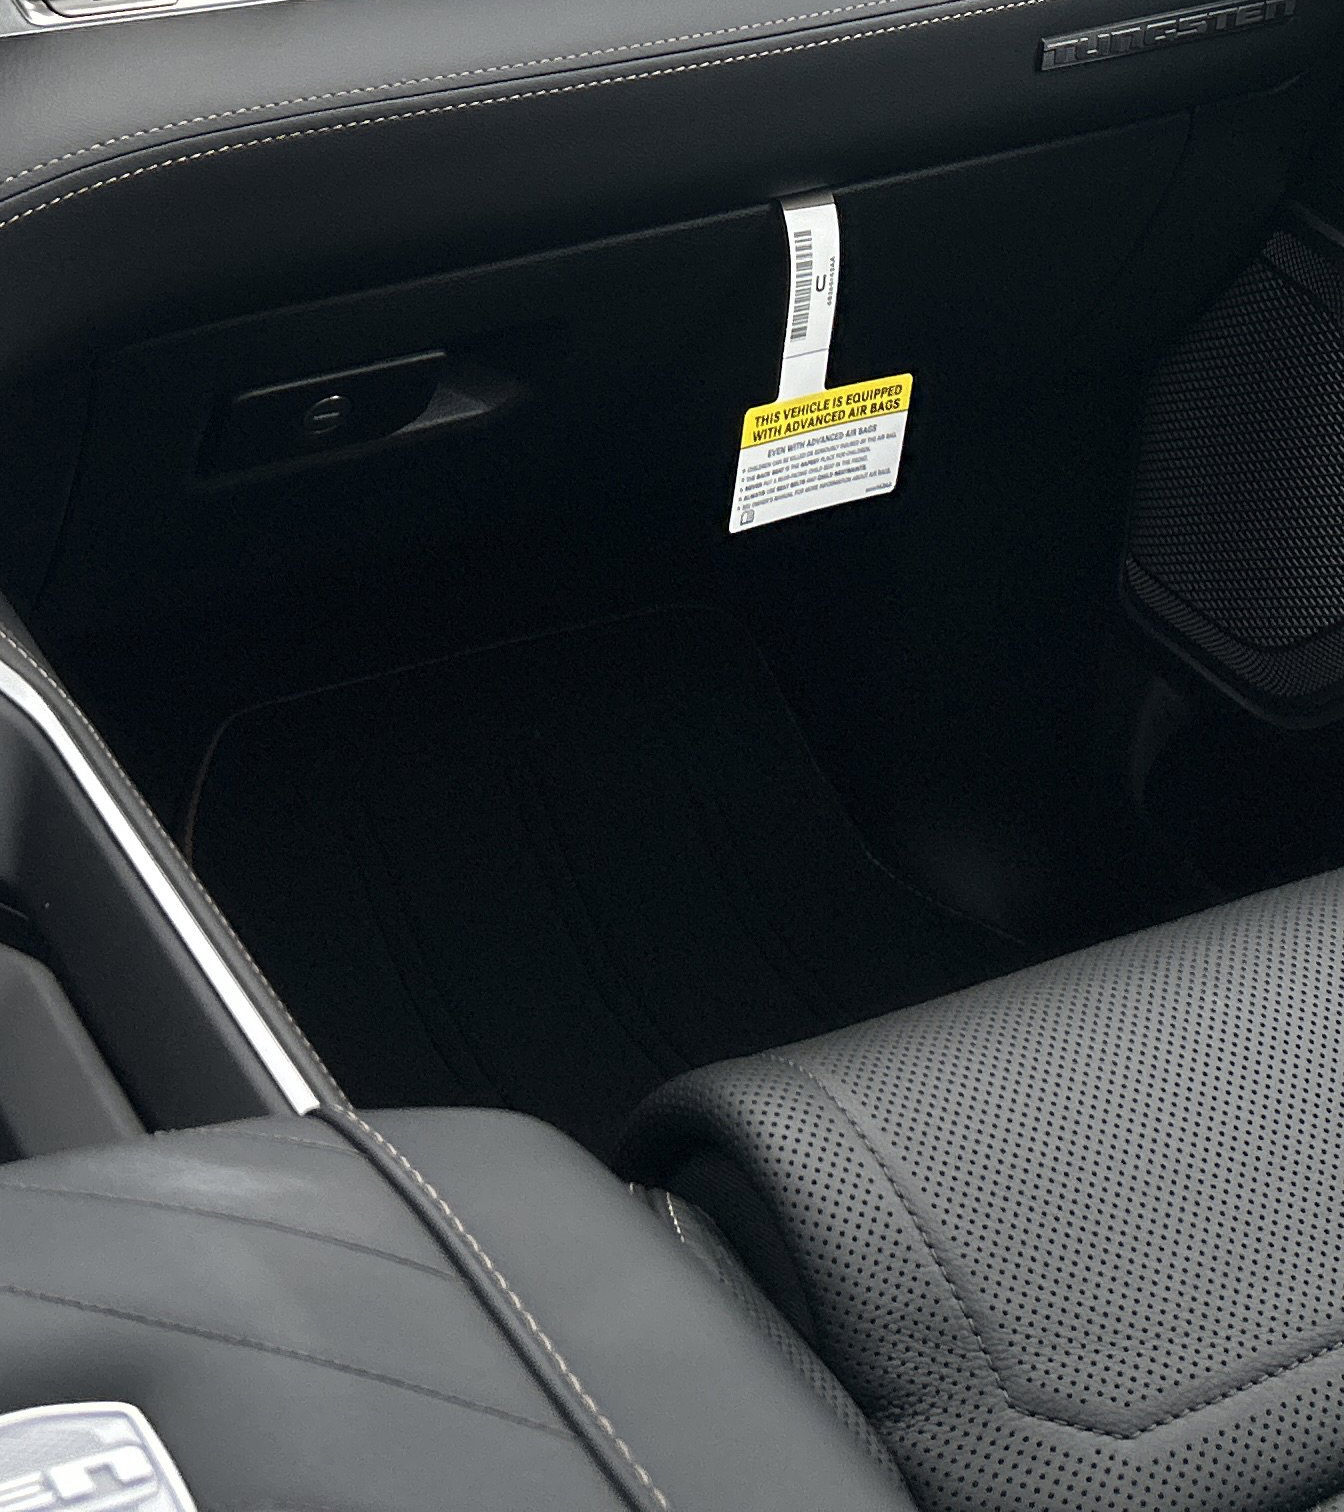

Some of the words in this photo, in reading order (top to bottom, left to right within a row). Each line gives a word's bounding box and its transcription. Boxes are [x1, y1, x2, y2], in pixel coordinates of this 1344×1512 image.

[752, 425, 782, 443] WITH
[784, 412, 846, 435] ADVANCED
[848, 403, 867, 419] AIR
[869, 397, 901, 414] BAGS
[755, 411, 780, 428] THIS
[783, 401, 830, 420] VEHICLE
[832, 396, 843, 409] IS
[846, 384, 903, 406] EQUIPPED
[787, 441, 805, 453] WITH
[806, 432, 844, 448] ADVANCED
[845, 427, 857, 438] AIR
[858, 424, 878, 436] BAGS
